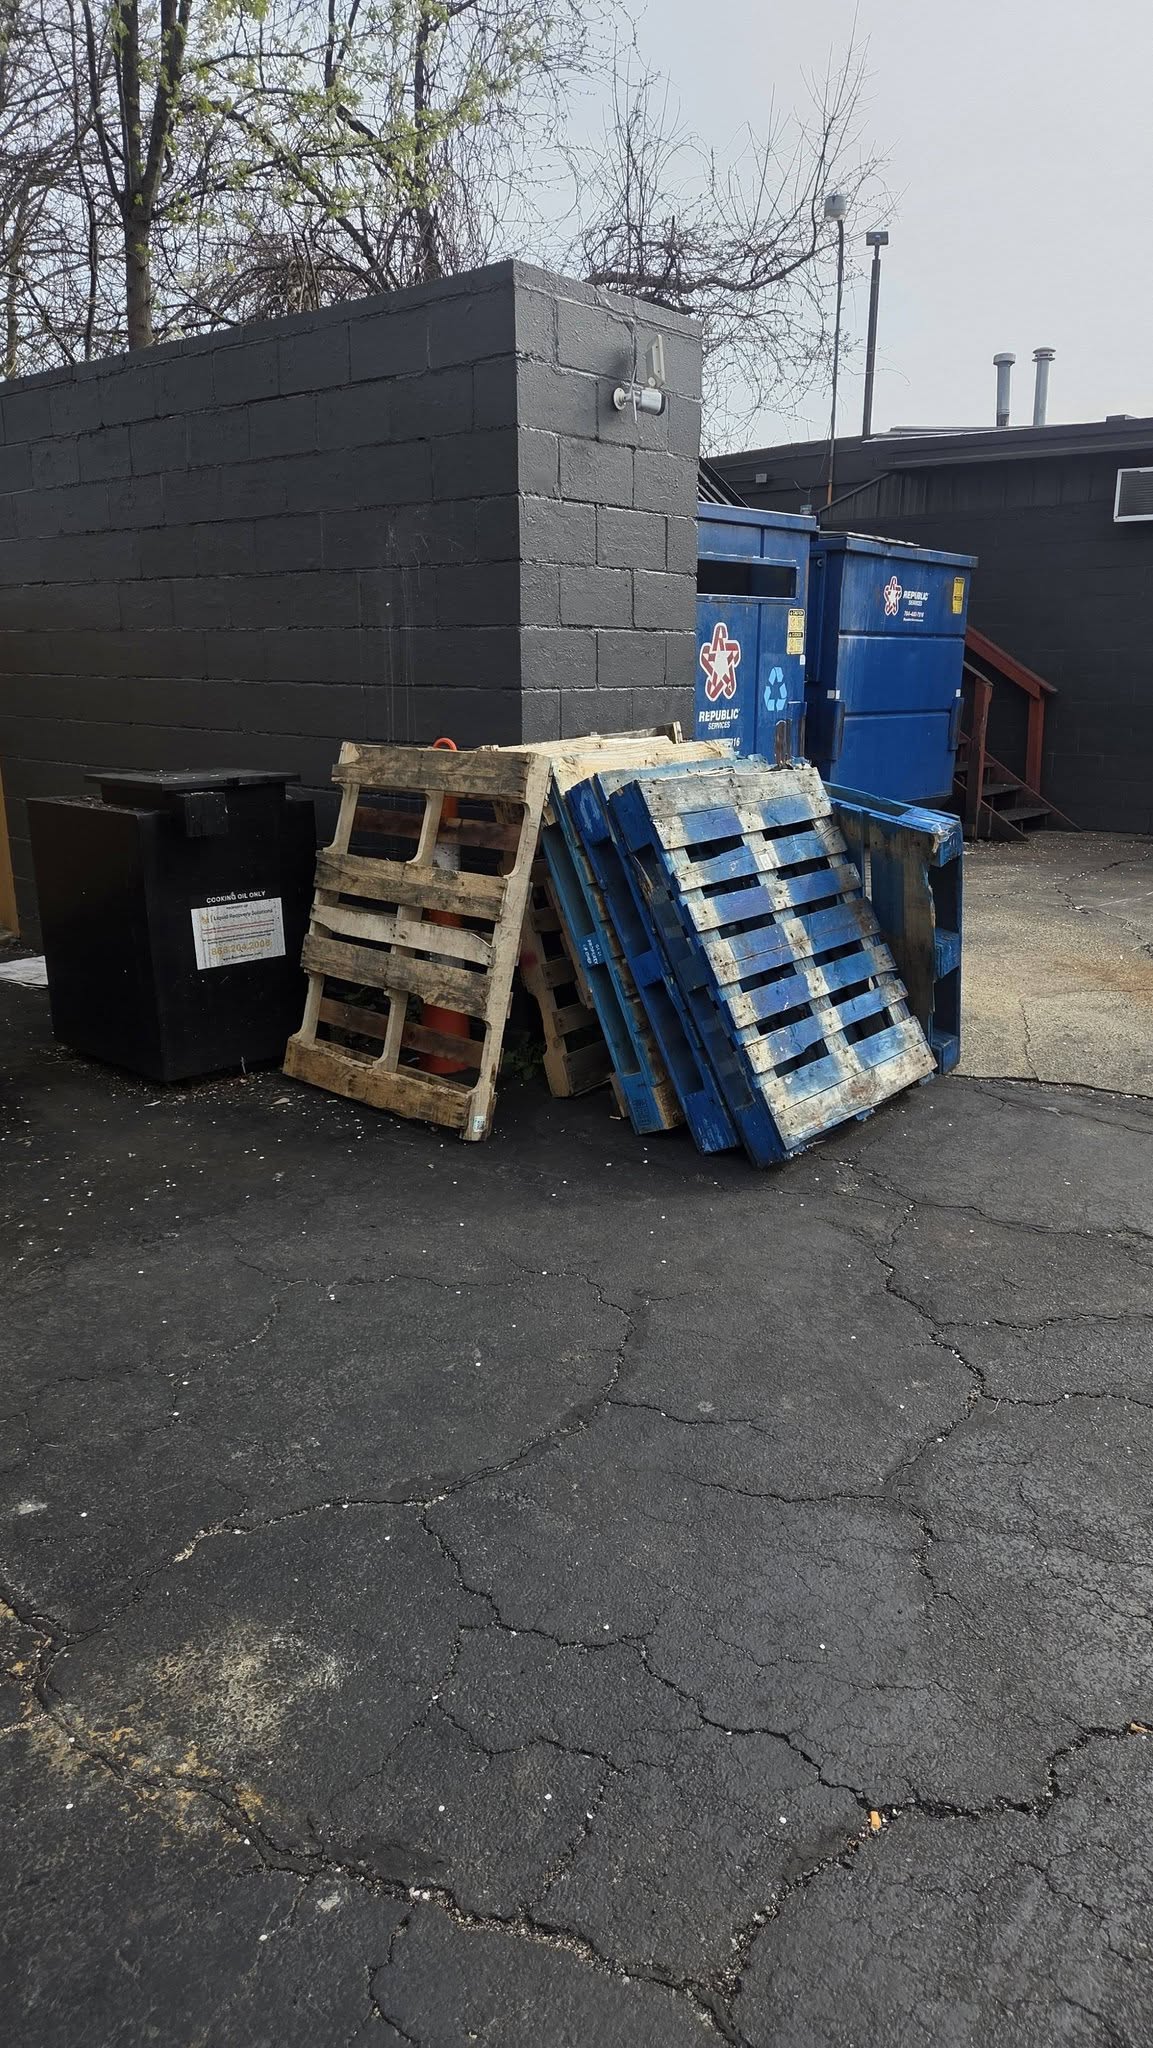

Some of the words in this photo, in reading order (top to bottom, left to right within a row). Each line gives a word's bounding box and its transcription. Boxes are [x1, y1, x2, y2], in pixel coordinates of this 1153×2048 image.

[903, 591, 929, 601] REPUBLIC
[698, 708, 739, 723] REPUBLIC
[708, 720, 731, 730] SERVICES
[206, 893, 237, 904] COOKING
[237, 892, 249, 900] OIL
[249, 890, 266, 899] ONLY
[213, 914, 229, 922] Liquid
[229, 911, 251, 919] Recovery
[251, 908, 273, 916] Solutions
